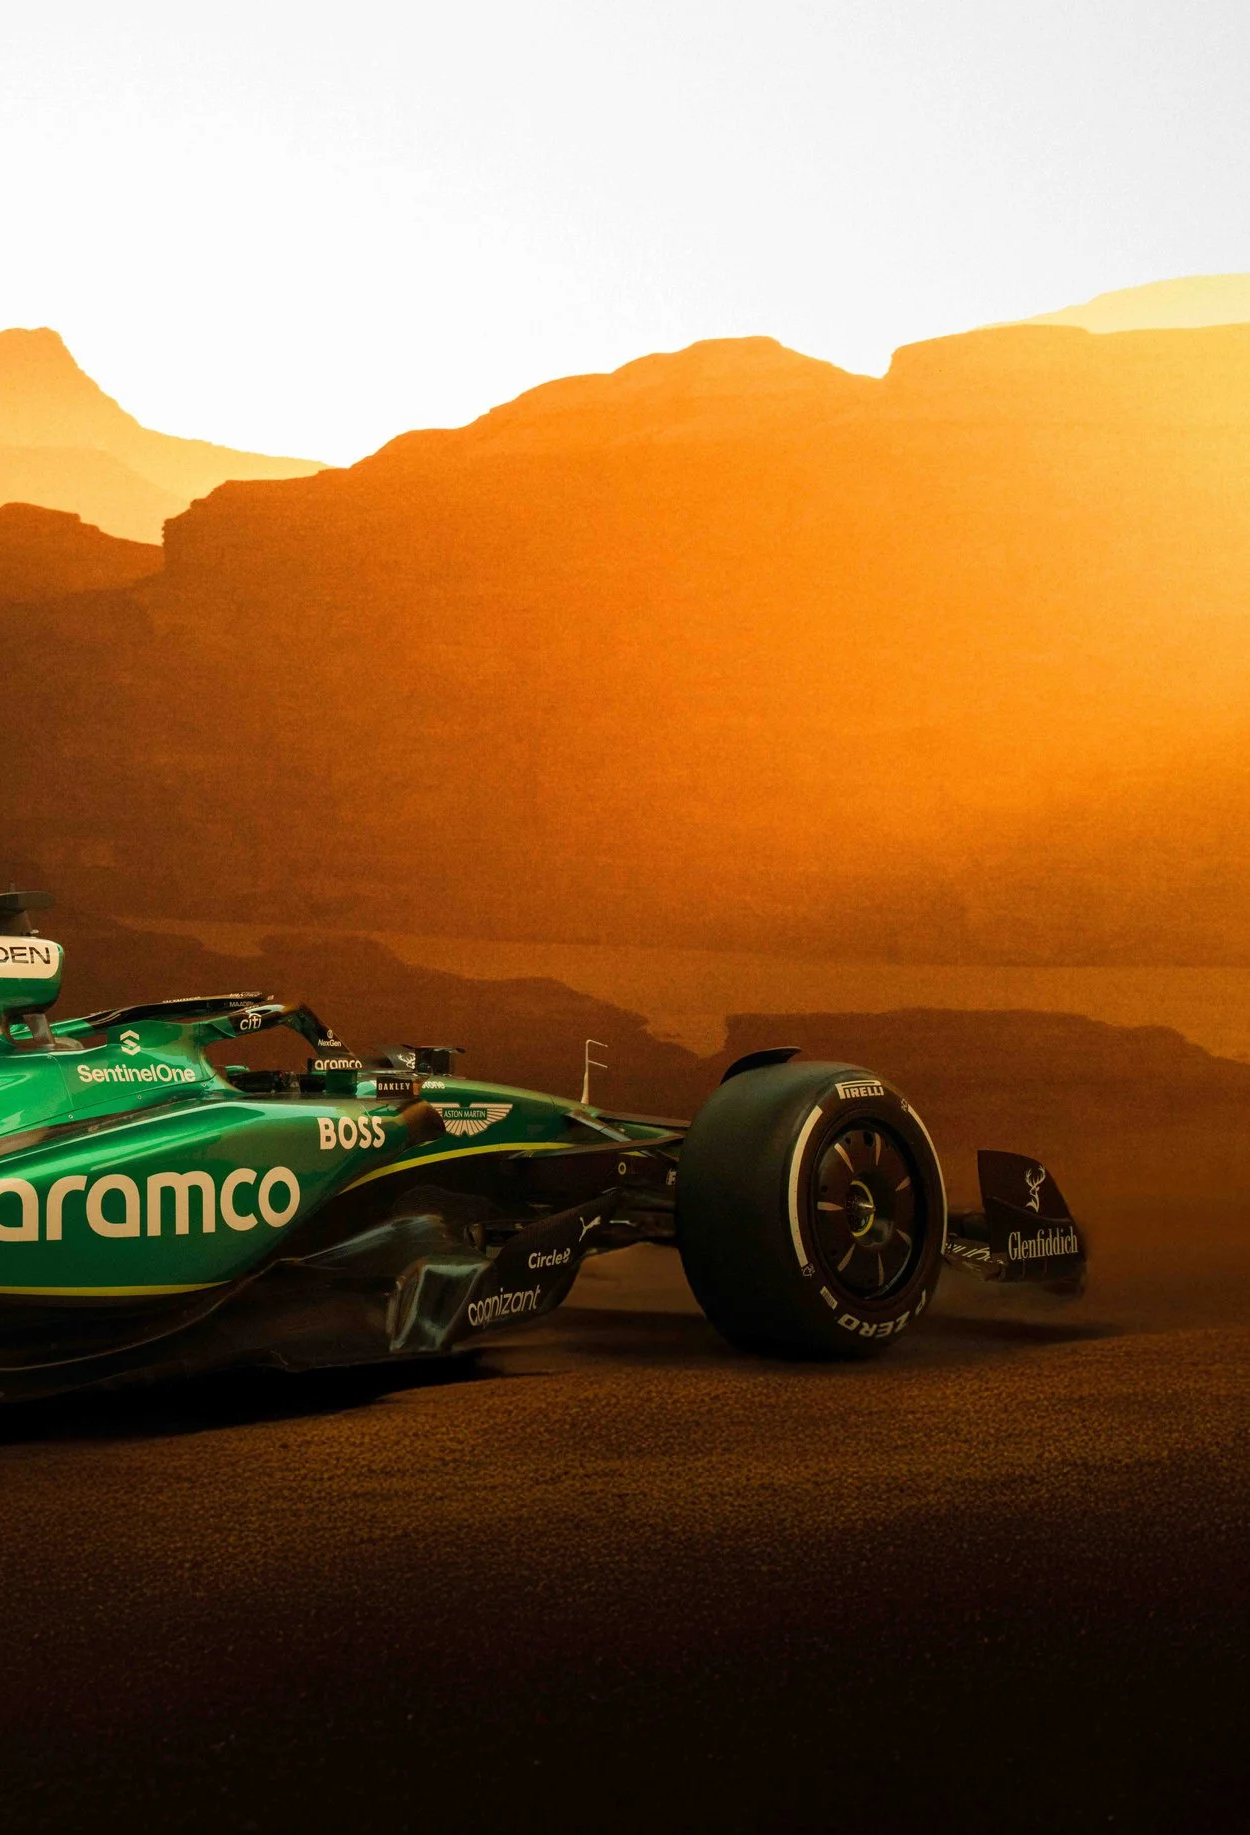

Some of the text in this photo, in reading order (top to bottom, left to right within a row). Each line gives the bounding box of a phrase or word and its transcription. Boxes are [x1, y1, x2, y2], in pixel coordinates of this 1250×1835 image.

[239, 1013, 262, 1031] citi
[317, 1038, 342, 1047] NexGen
[77, 1064, 196, 1083] SentinelOne
[314, 1059, 363, 1070] aramco
[378, 1082, 411, 1091] OAKLEY
[834, 1079, 885, 1100] PIRELLI
[443, 1110, 486, 1118] ASTON MARTIN
[316, 1115, 386, 1150] BOSS
[1008, 1226, 1079, 1261] Glenfiddich
[467, 1283, 542, 1330] cognizant
[837, 1312, 911, 1339] ZERO
